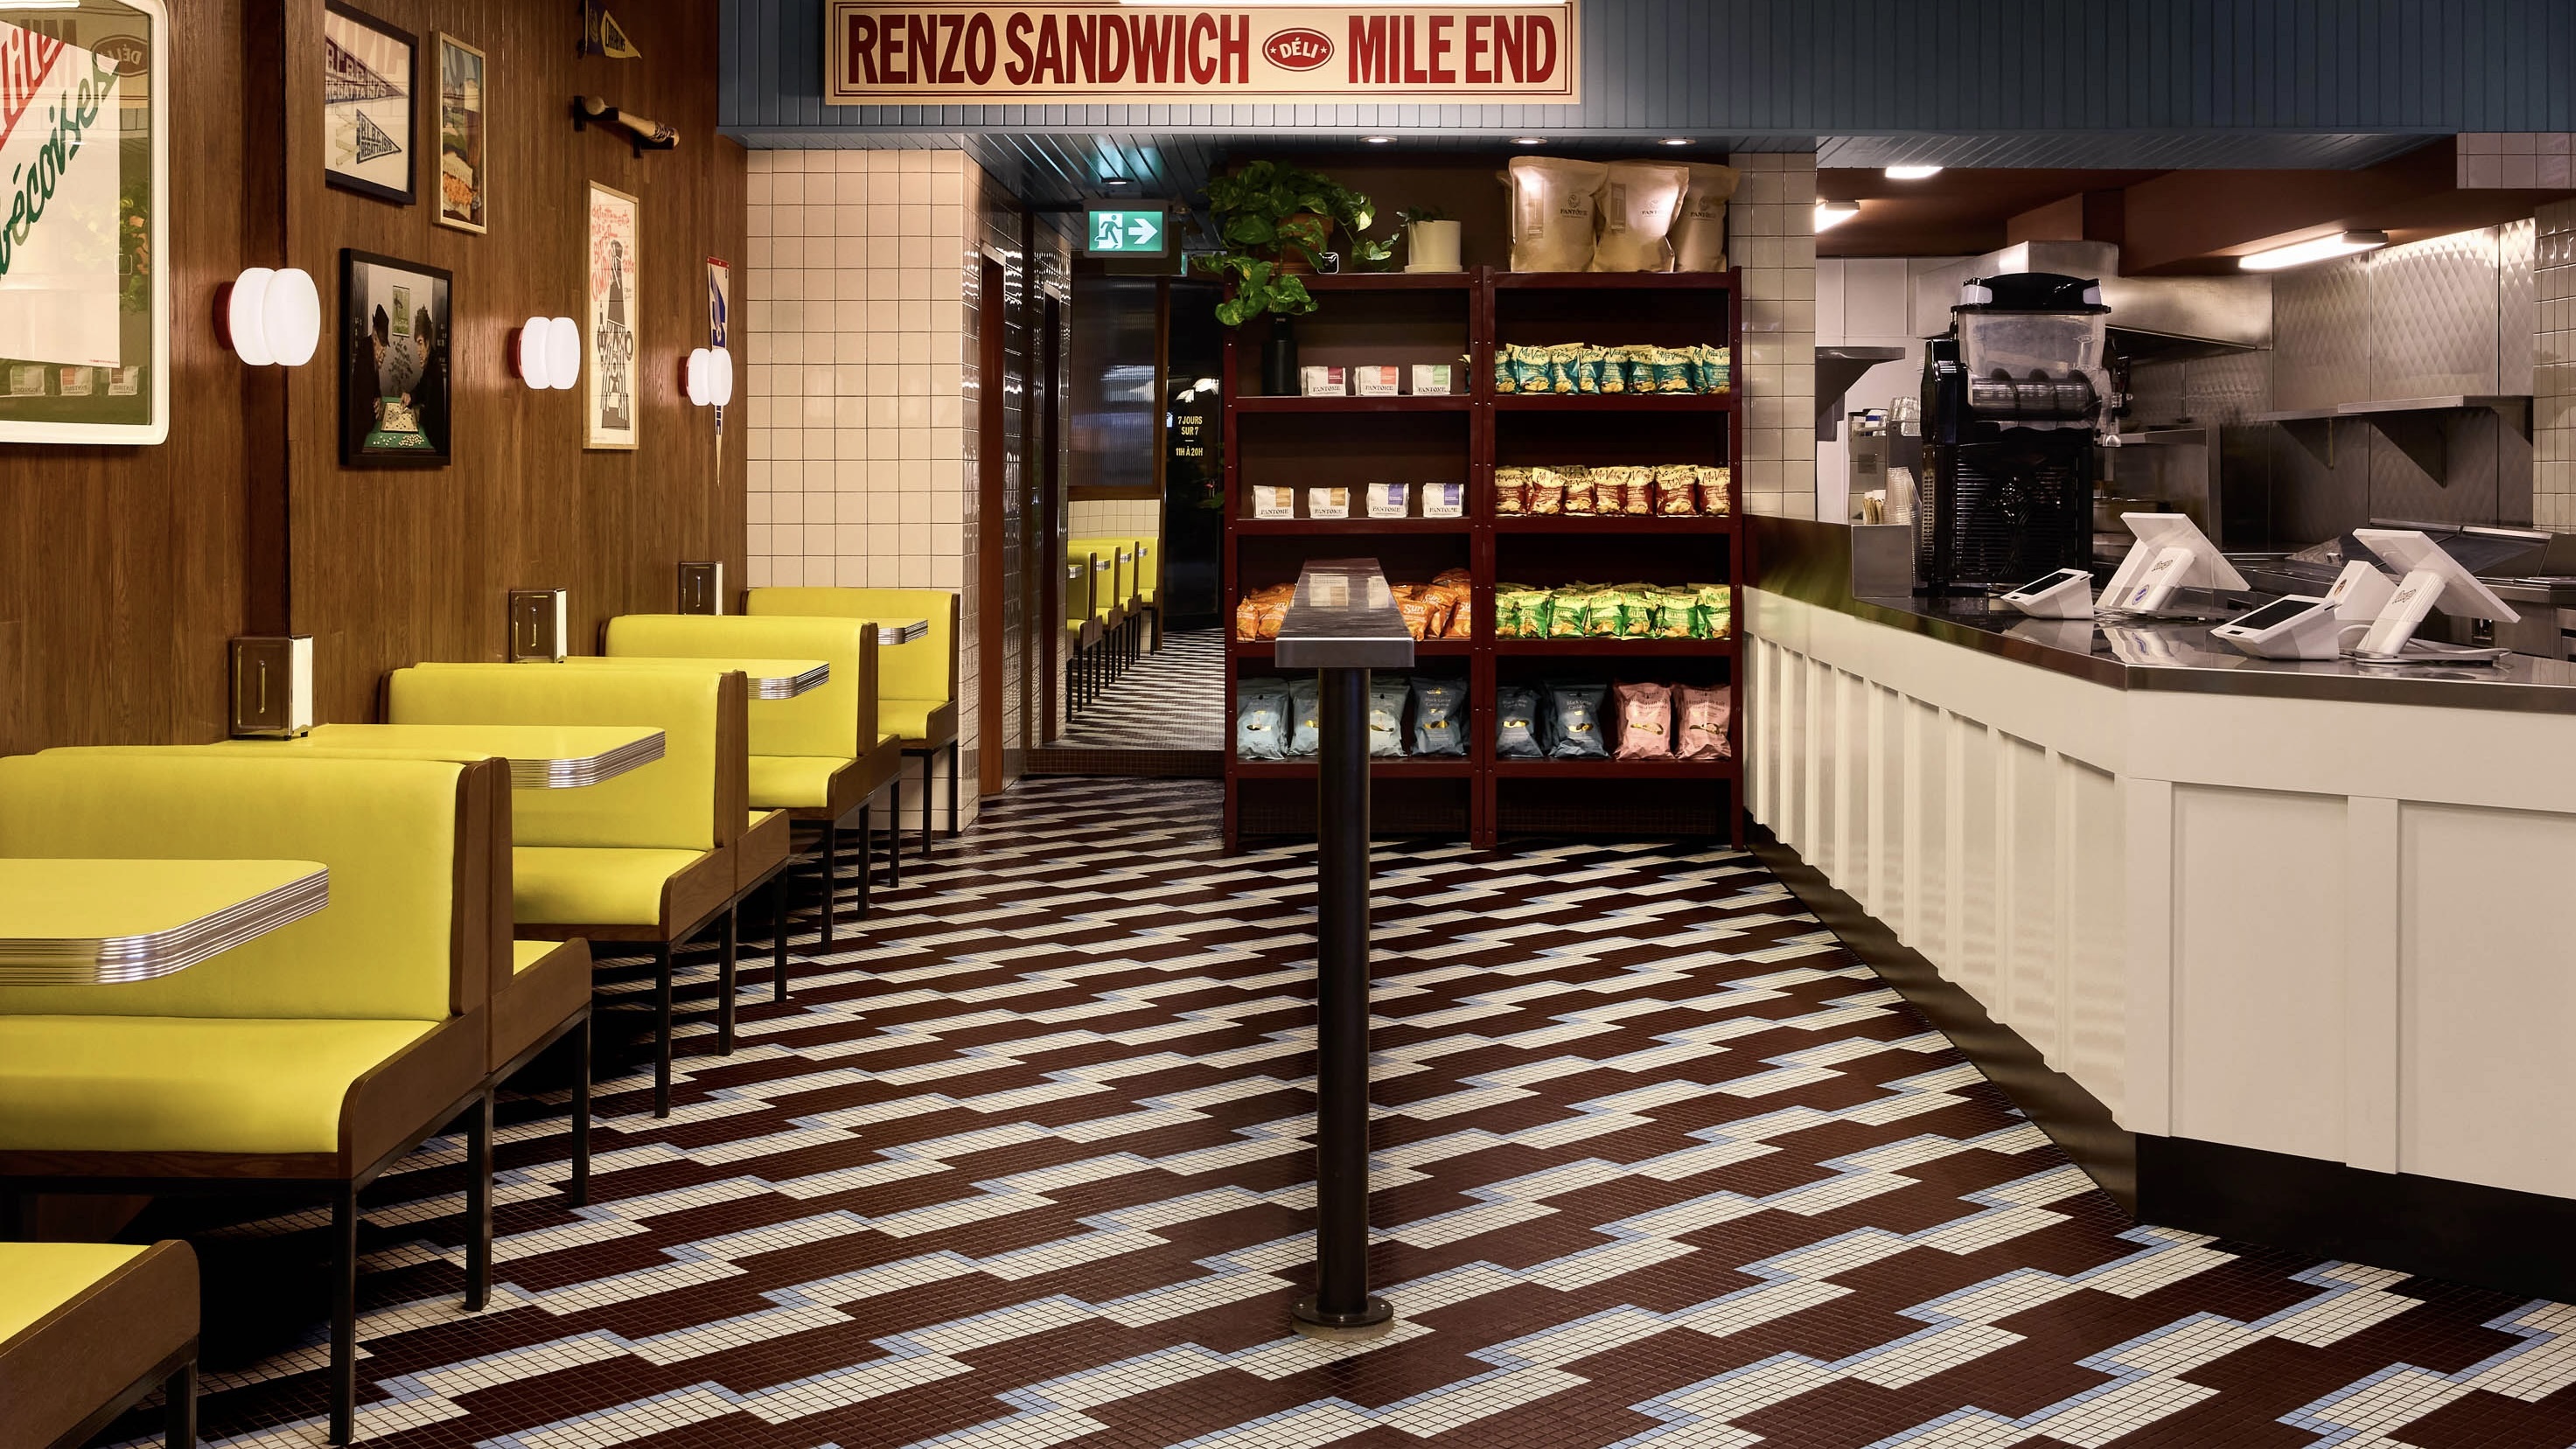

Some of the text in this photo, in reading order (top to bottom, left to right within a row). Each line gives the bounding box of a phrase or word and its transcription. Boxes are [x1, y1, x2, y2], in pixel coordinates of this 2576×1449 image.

[847, 13, 1250, 86] RENZO SANDWICH
[1278, 37, 1319, 59] DÉLI
[1348, 15, 1556, 84] MILE END
[325, 75, 366, 100] REGATTA
[361, 141, 382, 157] REGATTA
[1177, 415, 1203, 425] 7 JOURS
[1181, 426, 1199, 435] SUR 7
[1176, 445, 1204, 456] 11H À 20H
[1403, 603, 1425, 614] Sun
